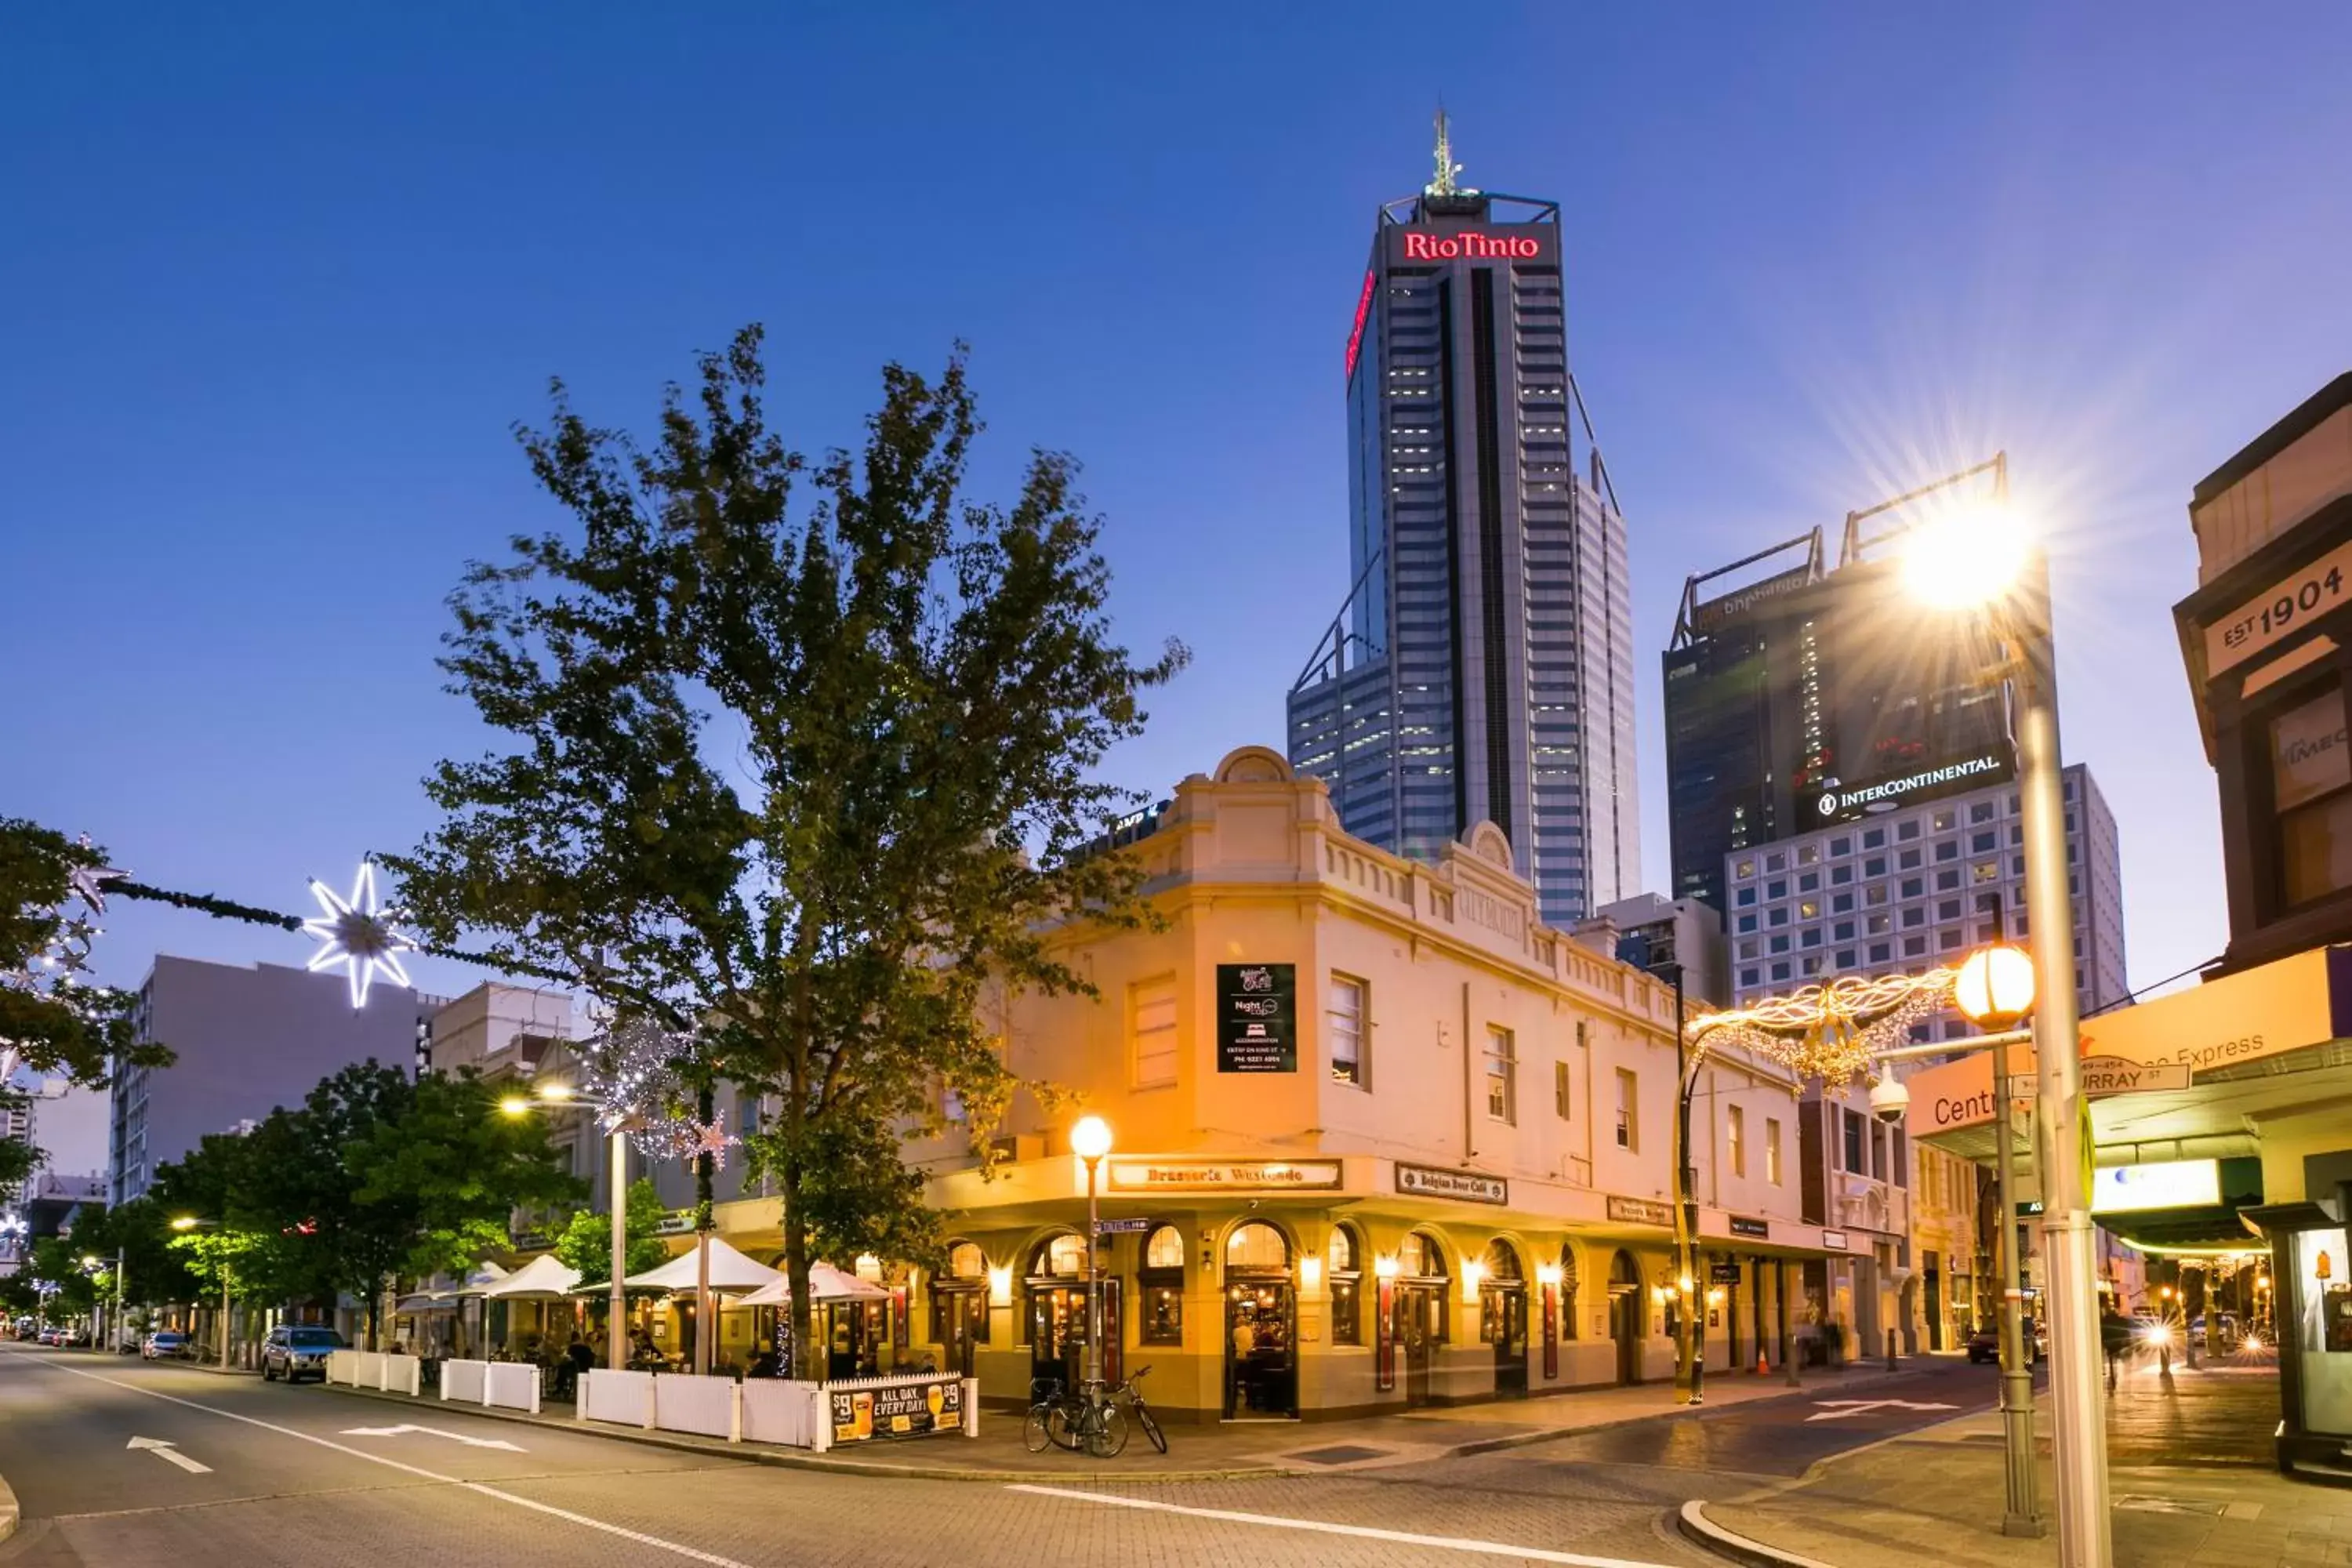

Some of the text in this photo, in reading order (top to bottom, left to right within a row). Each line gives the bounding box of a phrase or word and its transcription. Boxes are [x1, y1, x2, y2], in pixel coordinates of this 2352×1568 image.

[2223, 566, 2344, 648] EST 1904
[2177, 1034, 2264, 1070] Express
[882, 1390, 899, 1403] ALL
[944, 1384, 959, 1405] $9
[833, 1395, 852, 1417] $9
